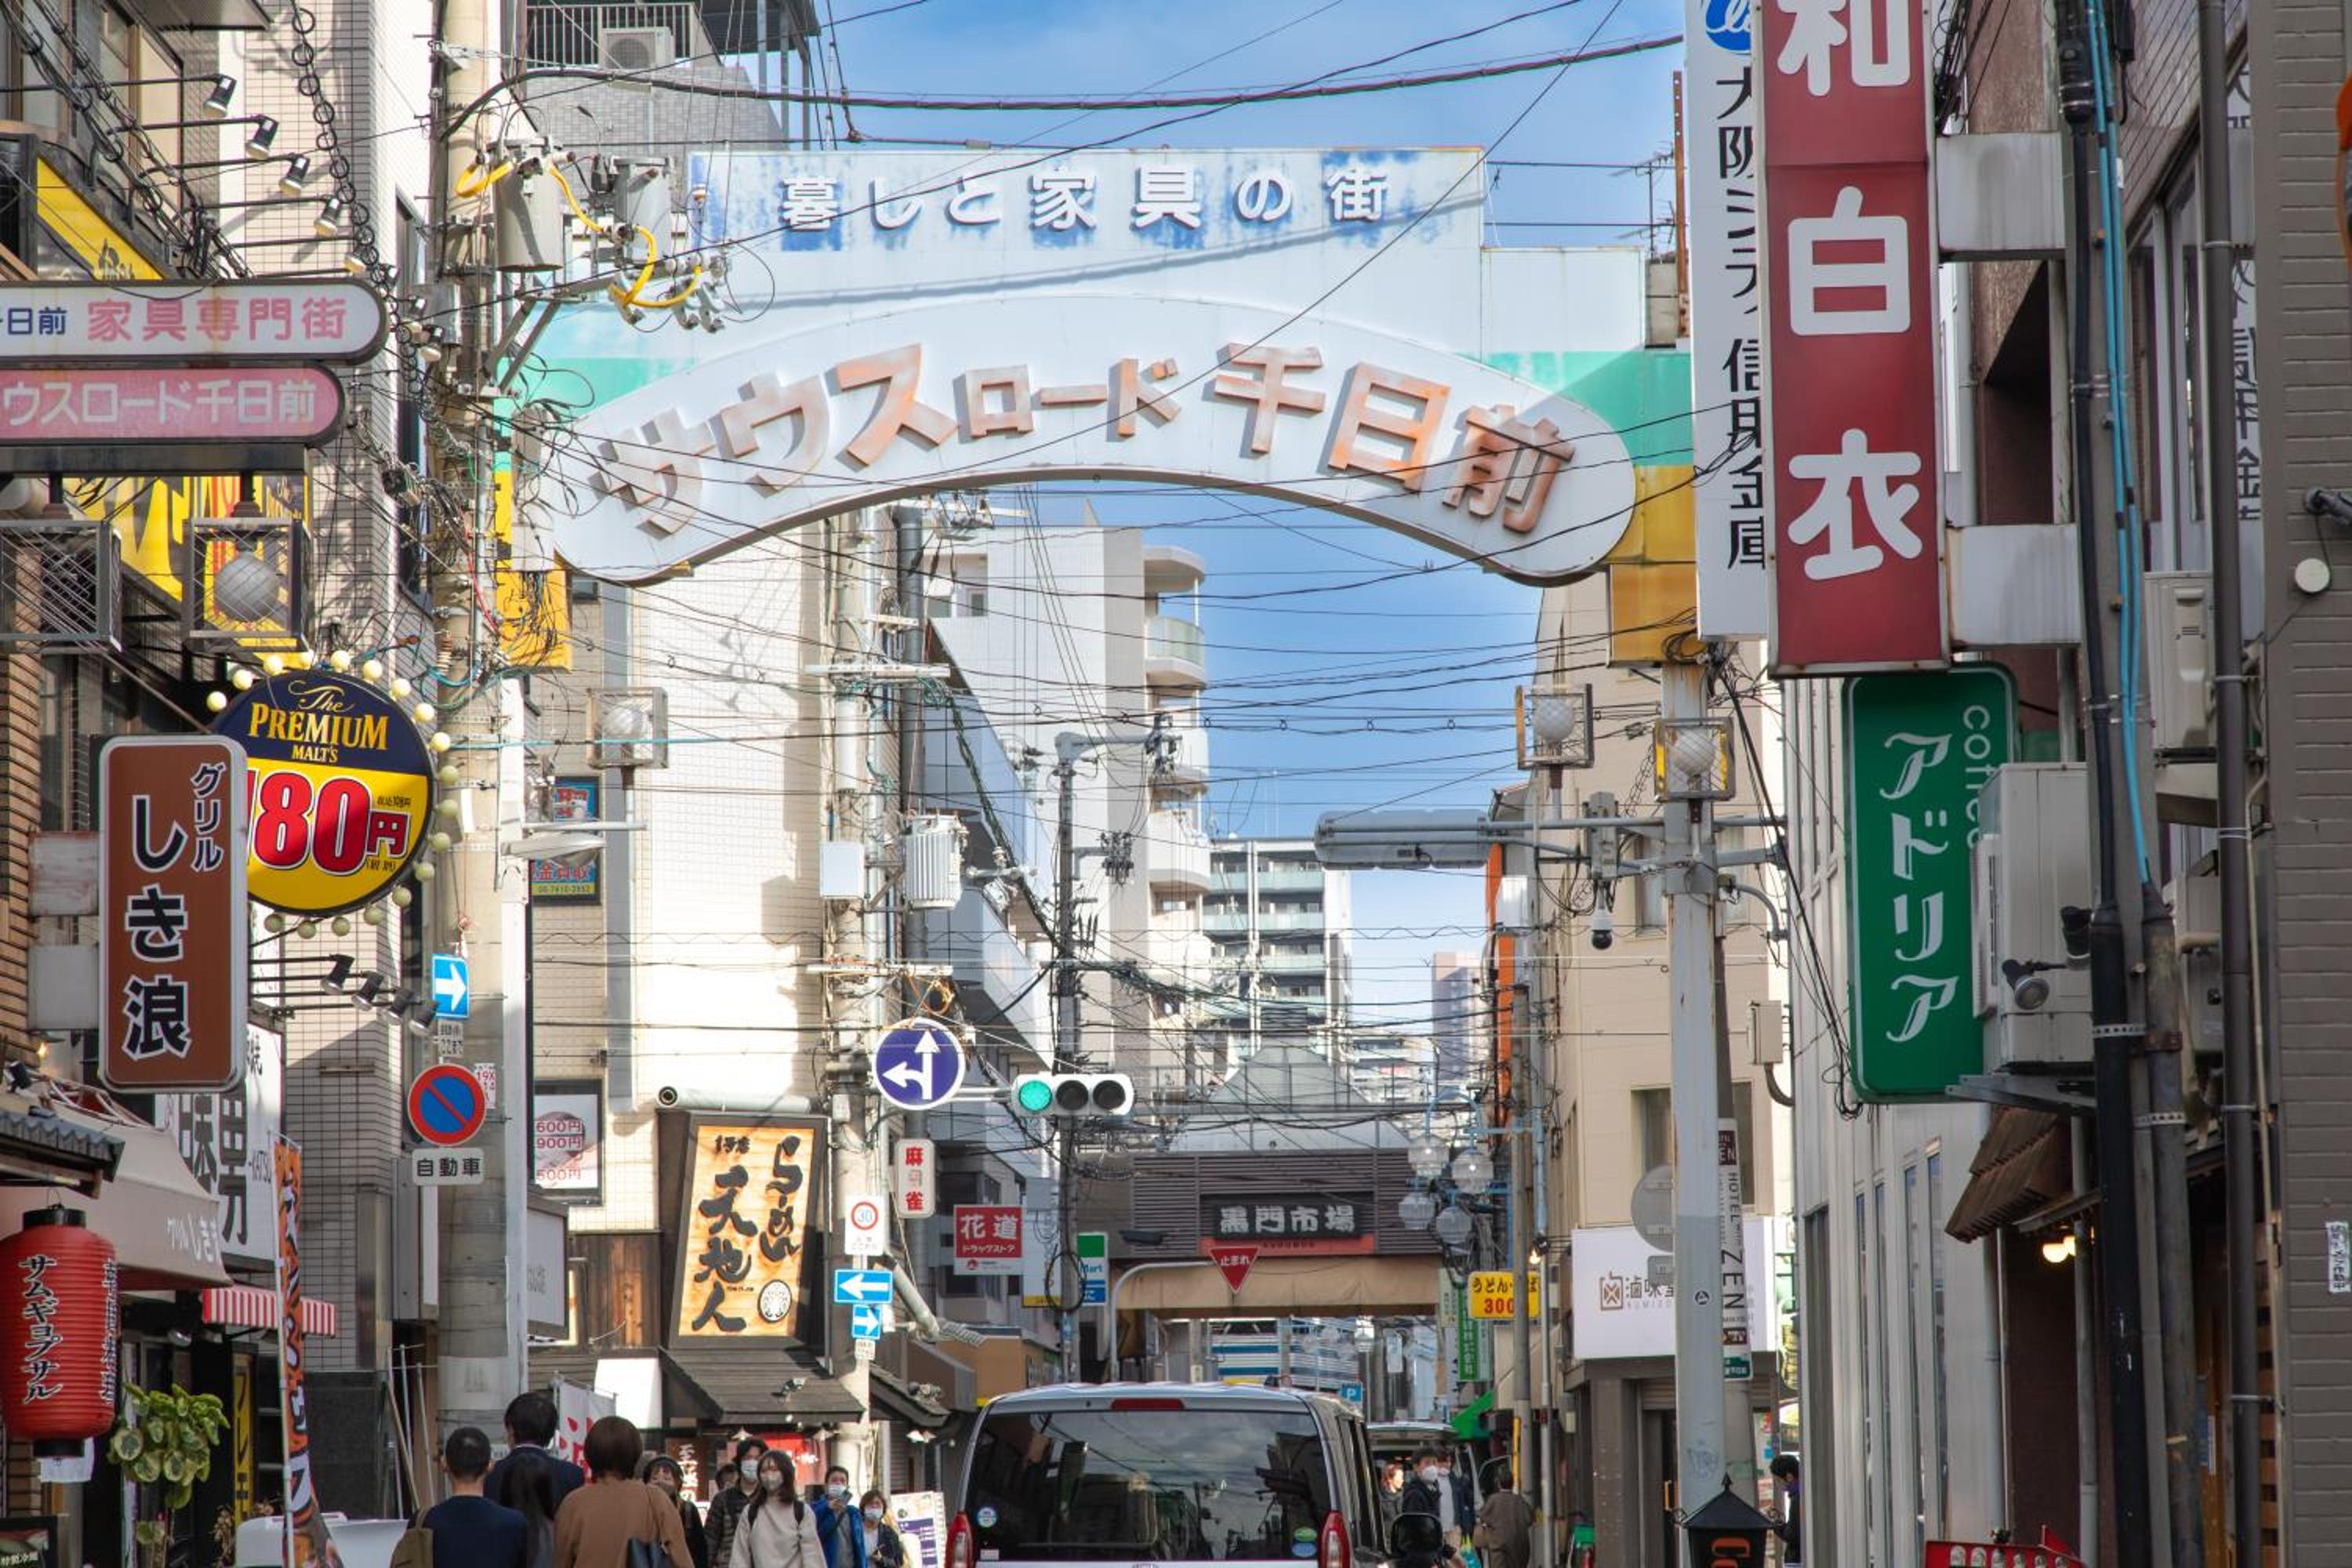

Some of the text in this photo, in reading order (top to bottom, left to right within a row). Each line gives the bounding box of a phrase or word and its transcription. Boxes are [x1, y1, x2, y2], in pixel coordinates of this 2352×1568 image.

[782, 163, 1392, 232] 暮しと家具の街
[1777, 0, 1923, 580] 和白衣
[0, 296, 347, 343] 日前 家具専門街
[588, 342, 1576, 535] ザウスロード千日前
[289, 679, 353, 713] The
[249, 703, 389, 751] PREMIUM
[291, 746, 339, 764] MALT'S
[191, 761, 226, 872] グリル
[1880, 732, 1958, 1043] アドリア
[122, 794, 192, 1061] しき浪
[536, 1120, 583, 1134] 600円
[537, 1136, 583, 1149] 900円
[416, 1157, 481, 1177] 自動車
[536, 1167, 583, 1181] 500円
[1221, 1205, 1355, 1232] 黒門市場
[1728, 1172, 1740, 1222] HOTEL
[691, 1164, 758, 1332] 天地人
[960, 1214, 1018, 1240] 花道
[1221, 1256, 1250, 1266] 止まれ
[1721, 1250, 1744, 1308] ZEN
[1472, 1277, 1537, 1293] うどん・ば
[19, 1253, 63, 1404] サムギョプサル
